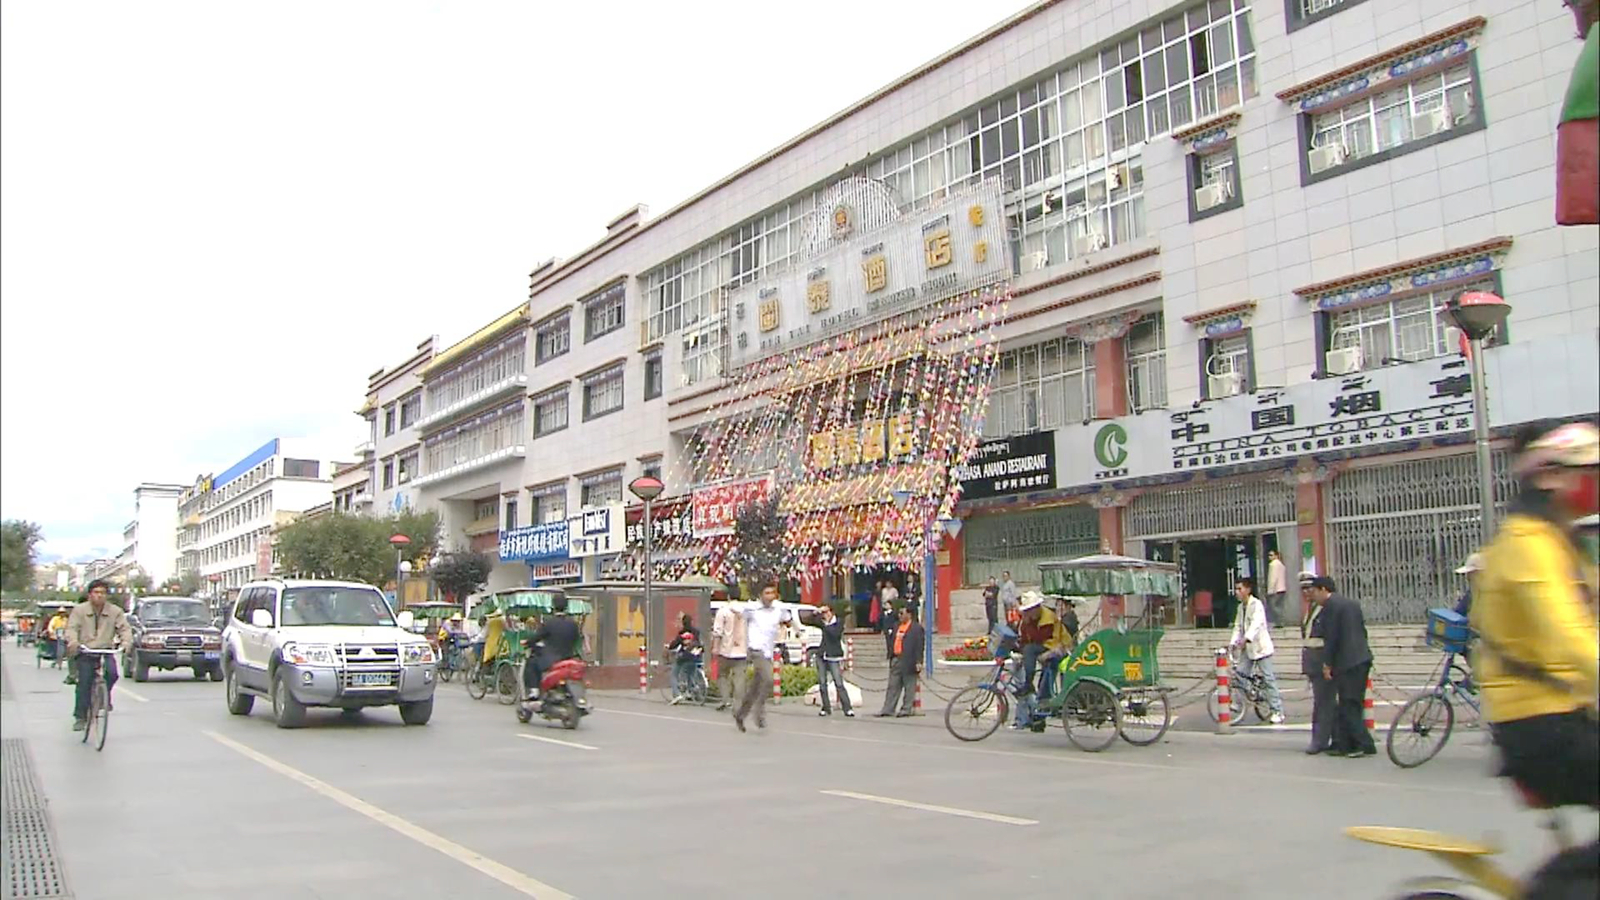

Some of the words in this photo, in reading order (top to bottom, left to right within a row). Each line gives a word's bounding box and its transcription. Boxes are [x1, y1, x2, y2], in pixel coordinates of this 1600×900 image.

[1173, 434, 1276, 457] CHINA
[1306, 403, 1474, 437] TOBACC
[983, 460, 1007, 478] ANAND
[1007, 453, 1048, 474] RESTAURANT
